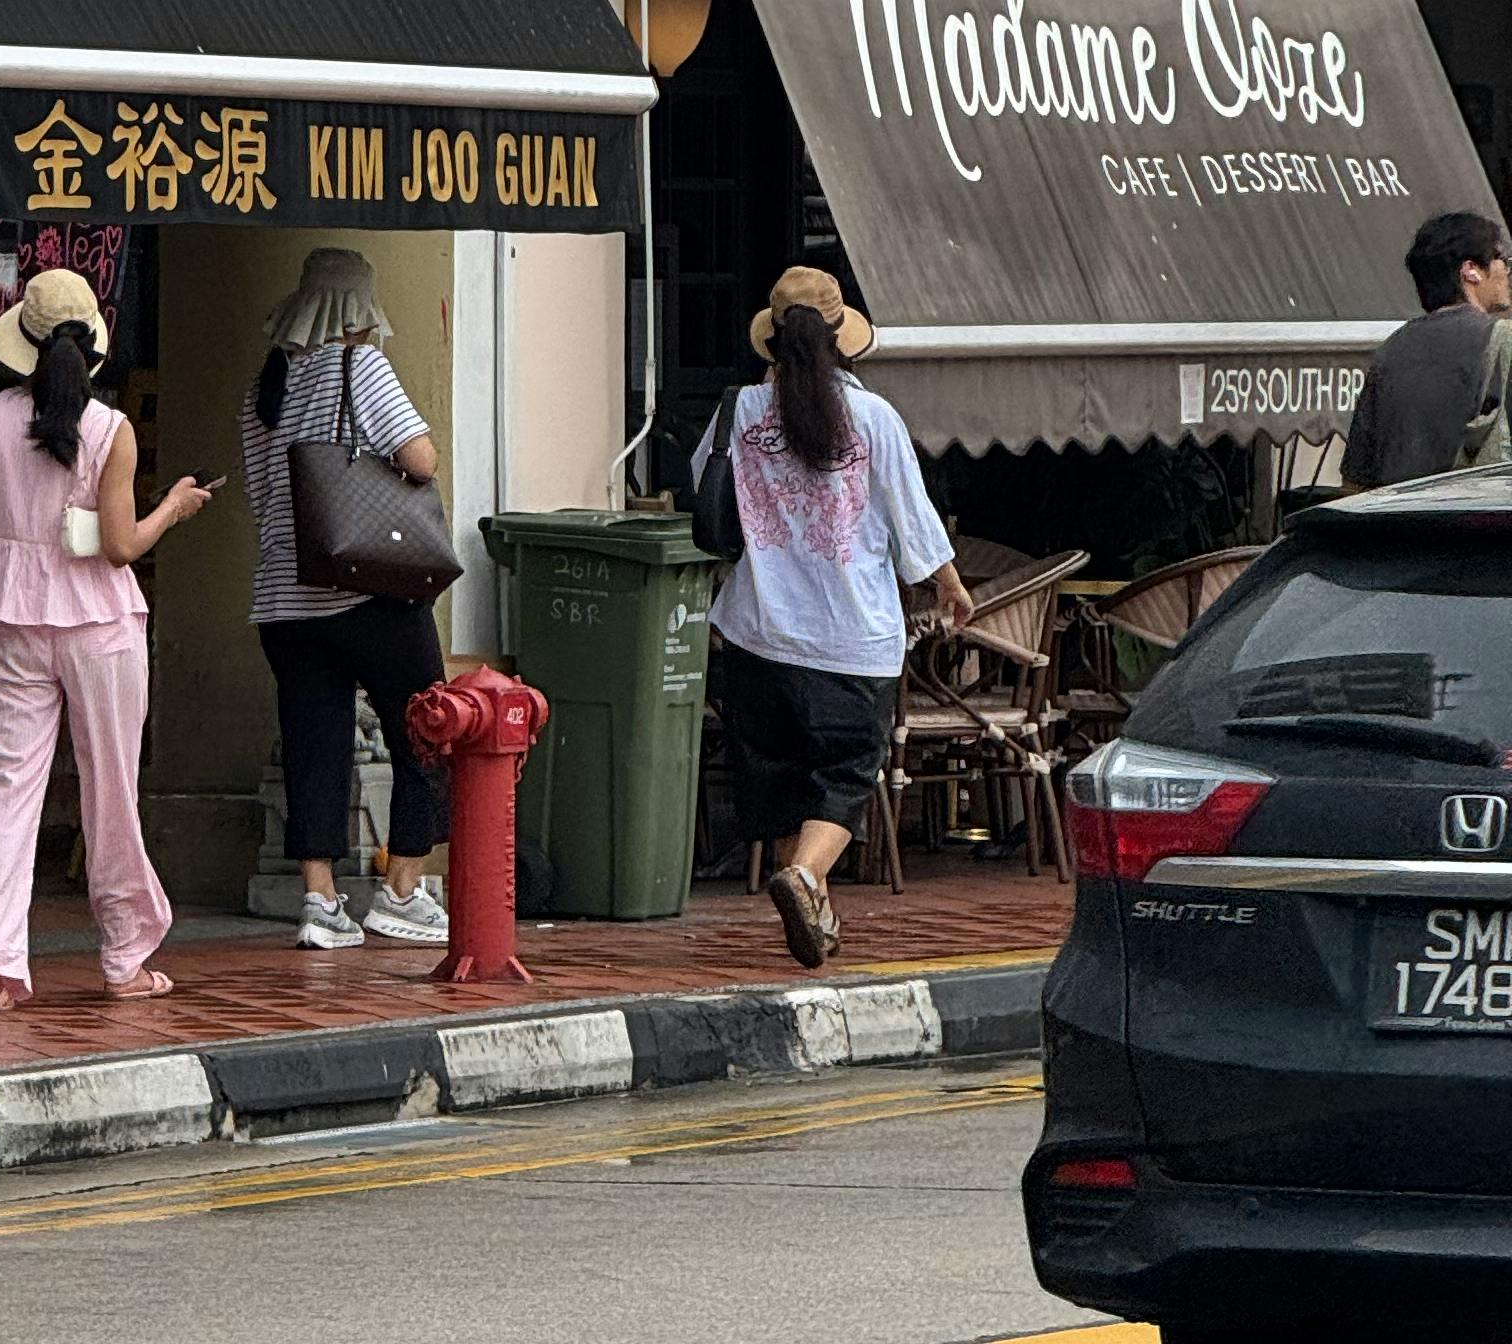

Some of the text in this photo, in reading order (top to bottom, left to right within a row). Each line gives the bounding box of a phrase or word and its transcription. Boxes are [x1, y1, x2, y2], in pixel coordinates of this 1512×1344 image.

[14, 99, 278, 214] 金裕源
[308, 126, 598, 208] KIM JOO GUAN
[1101, 153, 1410, 198] CAFE DESSERT BAR
[1210, 368, 1252, 413] 259
[1255, 367, 1334, 413] SOUTH
[551, 554, 609, 581] 261A
[1130, 900, 1258, 924] SHUTTLE
